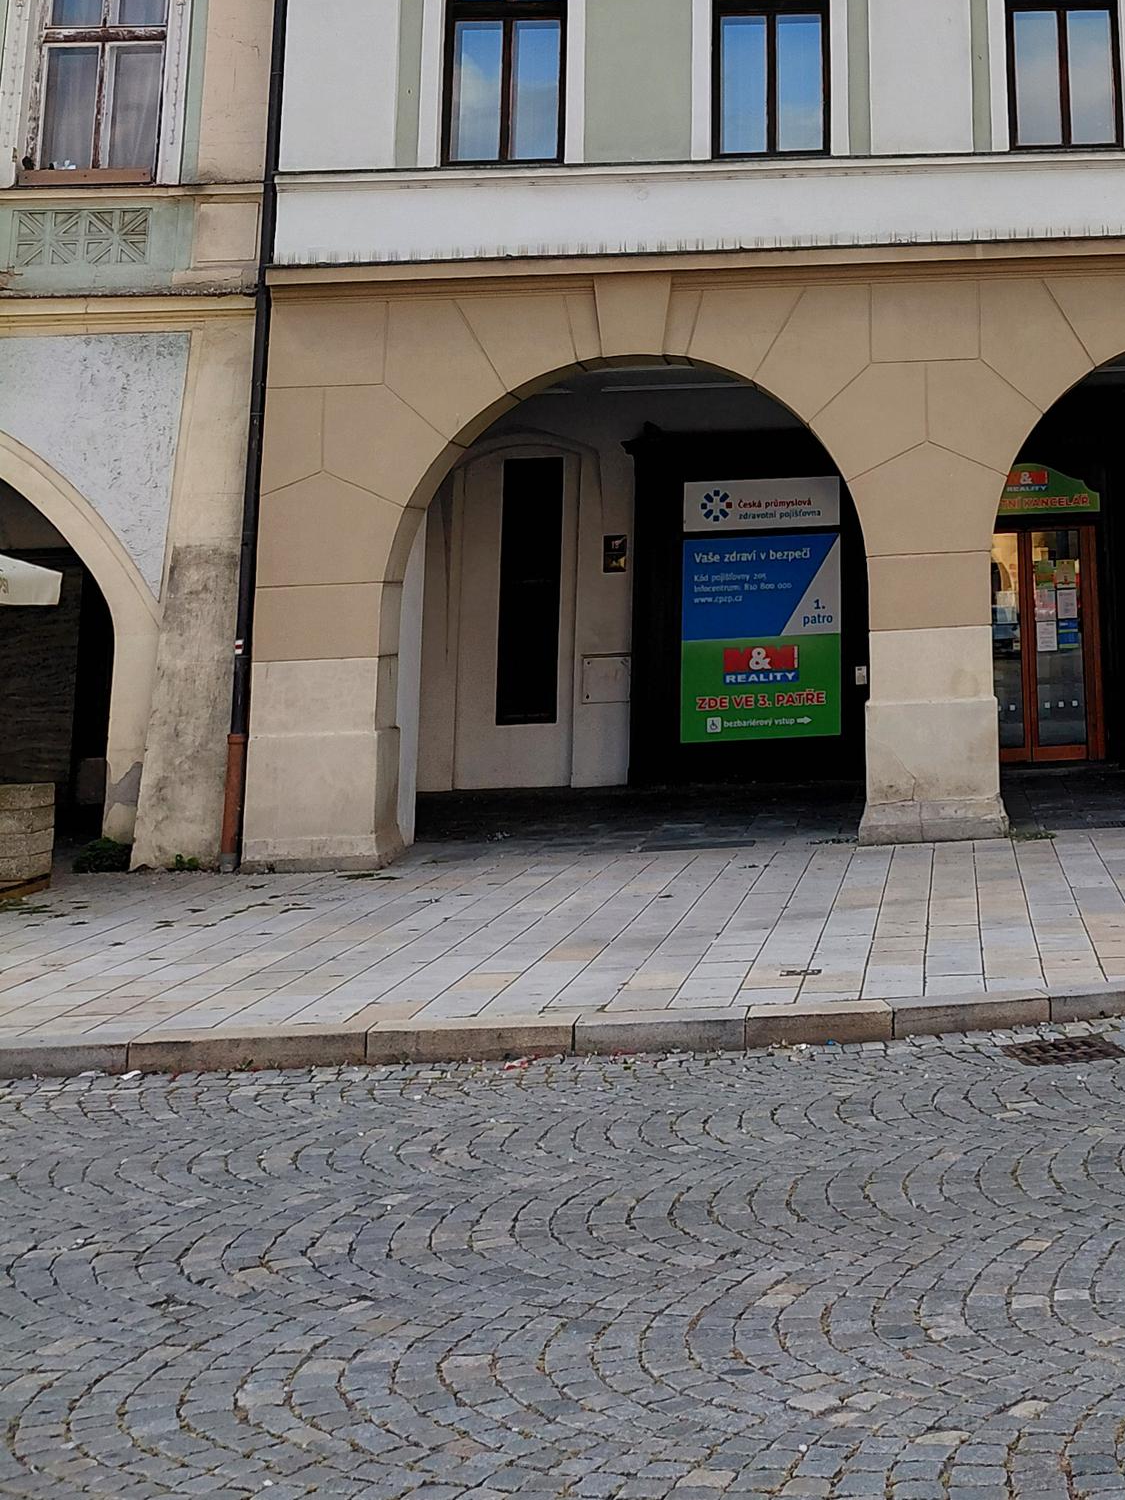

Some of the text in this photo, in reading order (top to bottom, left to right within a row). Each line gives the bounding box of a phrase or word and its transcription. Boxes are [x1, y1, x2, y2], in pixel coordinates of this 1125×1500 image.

[738, 497, 812, 509] Česká průmyslová
[738, 508, 821, 520] zdravotní pojišťovna
[694, 547, 811, 564] Vaše zdraví v bezpečí
[814, 599, 825, 610] 1.
[803, 614, 833, 627] patro
[725, 672, 796, 684] REALITY
[696, 689, 827, 712] ZDE VE 3. PATŘE
[774, 717, 795, 727] vstup
